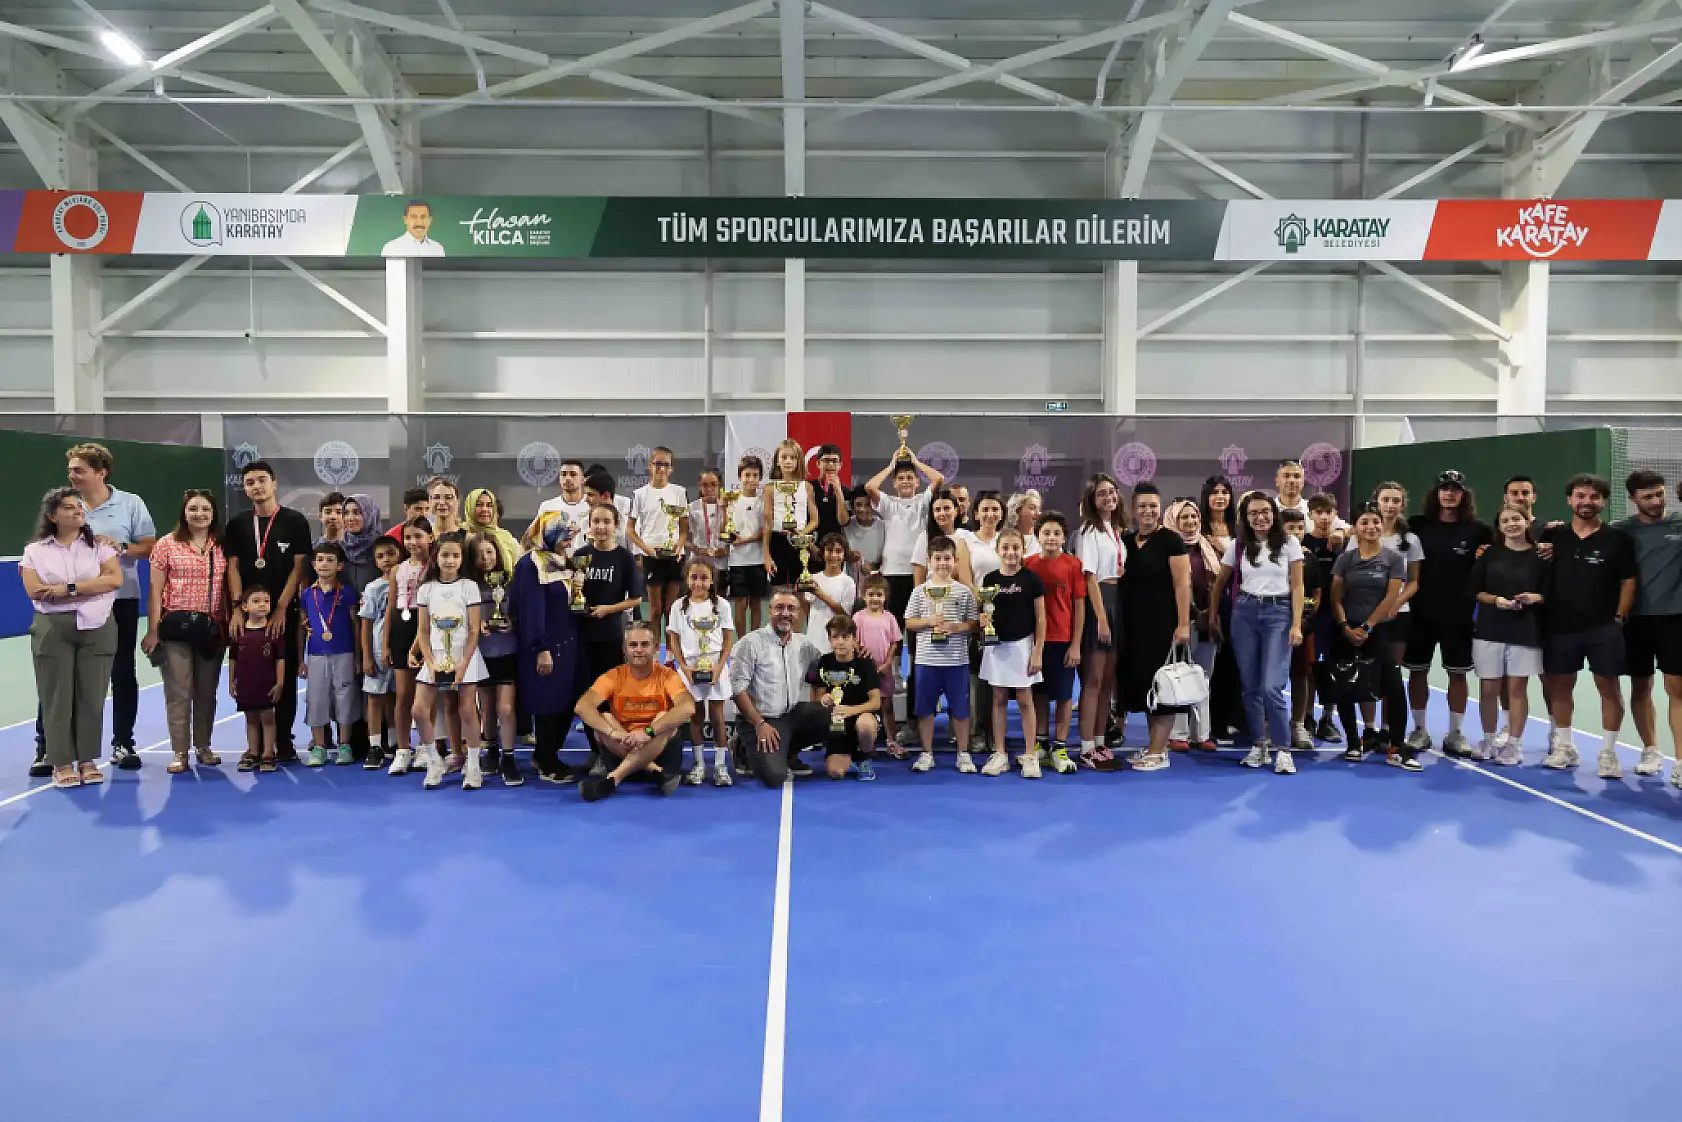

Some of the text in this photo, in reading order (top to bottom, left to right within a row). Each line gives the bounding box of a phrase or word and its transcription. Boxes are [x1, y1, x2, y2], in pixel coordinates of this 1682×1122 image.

[459, 207, 552, 234] Hasan
[1519, 202, 1569, 225] KAFE
[226, 224, 284, 238] KARATAY
[473, 230, 524, 245] KILCA
[658, 213, 1170, 246] TÜM SPORCULARIMIZA BAŞARILAR DİLERİM
[1313, 218, 1390, 238] KARATAY
[1497, 222, 1590, 250] KARATAY
